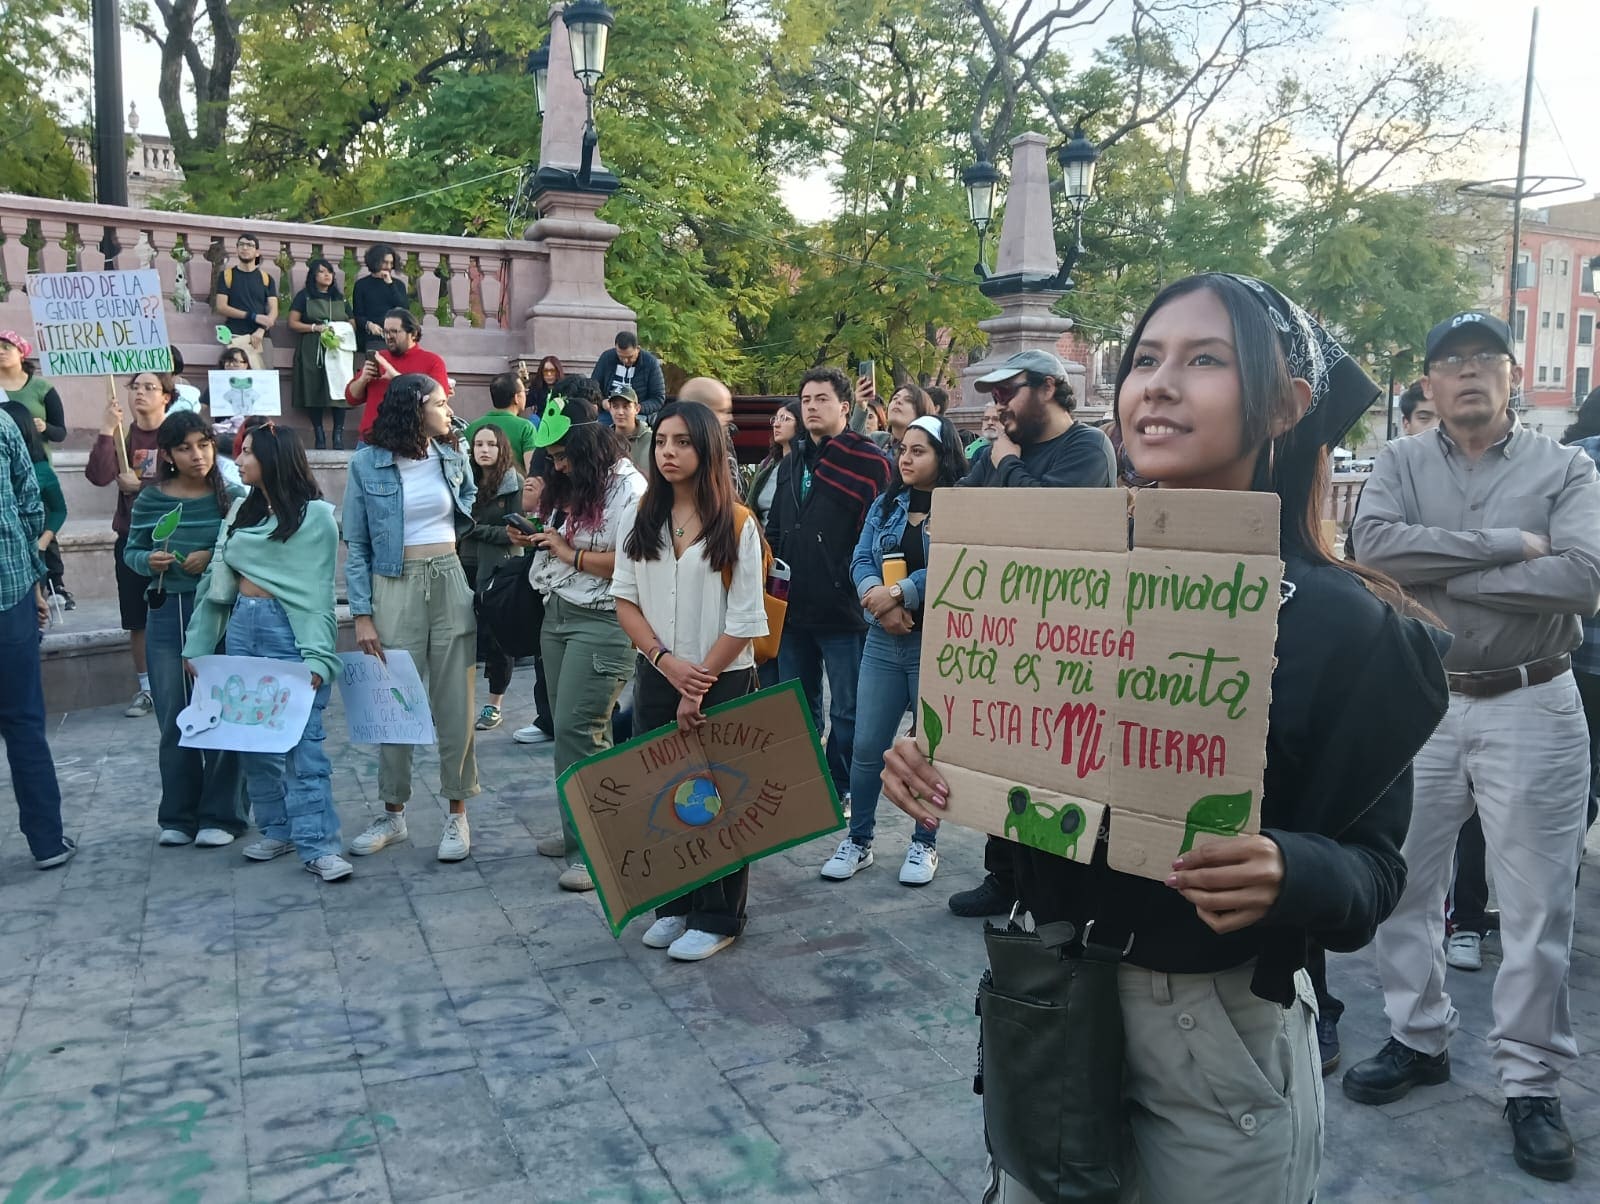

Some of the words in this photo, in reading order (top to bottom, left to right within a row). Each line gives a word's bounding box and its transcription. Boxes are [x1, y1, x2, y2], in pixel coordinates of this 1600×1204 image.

[99, 275, 120, 298] DE
[123, 274, 144, 296] LA
[45, 300, 89, 320] GENTE
[95, 295, 160, 319] BUENA??
[112, 319, 137, 346] DE
[138, 319, 162, 346] LA
[48, 351, 100, 376] RANITA
[933, 547, 988, 612] La
[1000, 560, 1111, 619] empresa
[1127, 562, 1269, 626] privada
[947, 611, 973, 640] NO
[980, 614, 1018, 647] NOS
[1036, 622, 1135, 661] DOBLEGA
[936, 641, 997, 685] esta
[1013, 652, 1042, 692] es
[1055, 658, 1094, 695] mi
[1117, 647, 1250, 720] ranita
[943, 694, 955, 734] Y
[972, 699, 1022, 746] ESTA
[1031, 707, 1054, 751] ES
[1117, 720, 1226, 778] TIERRA
[589, 776, 631, 816] SER
[620, 848, 652, 878] ES
[673, 837, 712, 870] SER
